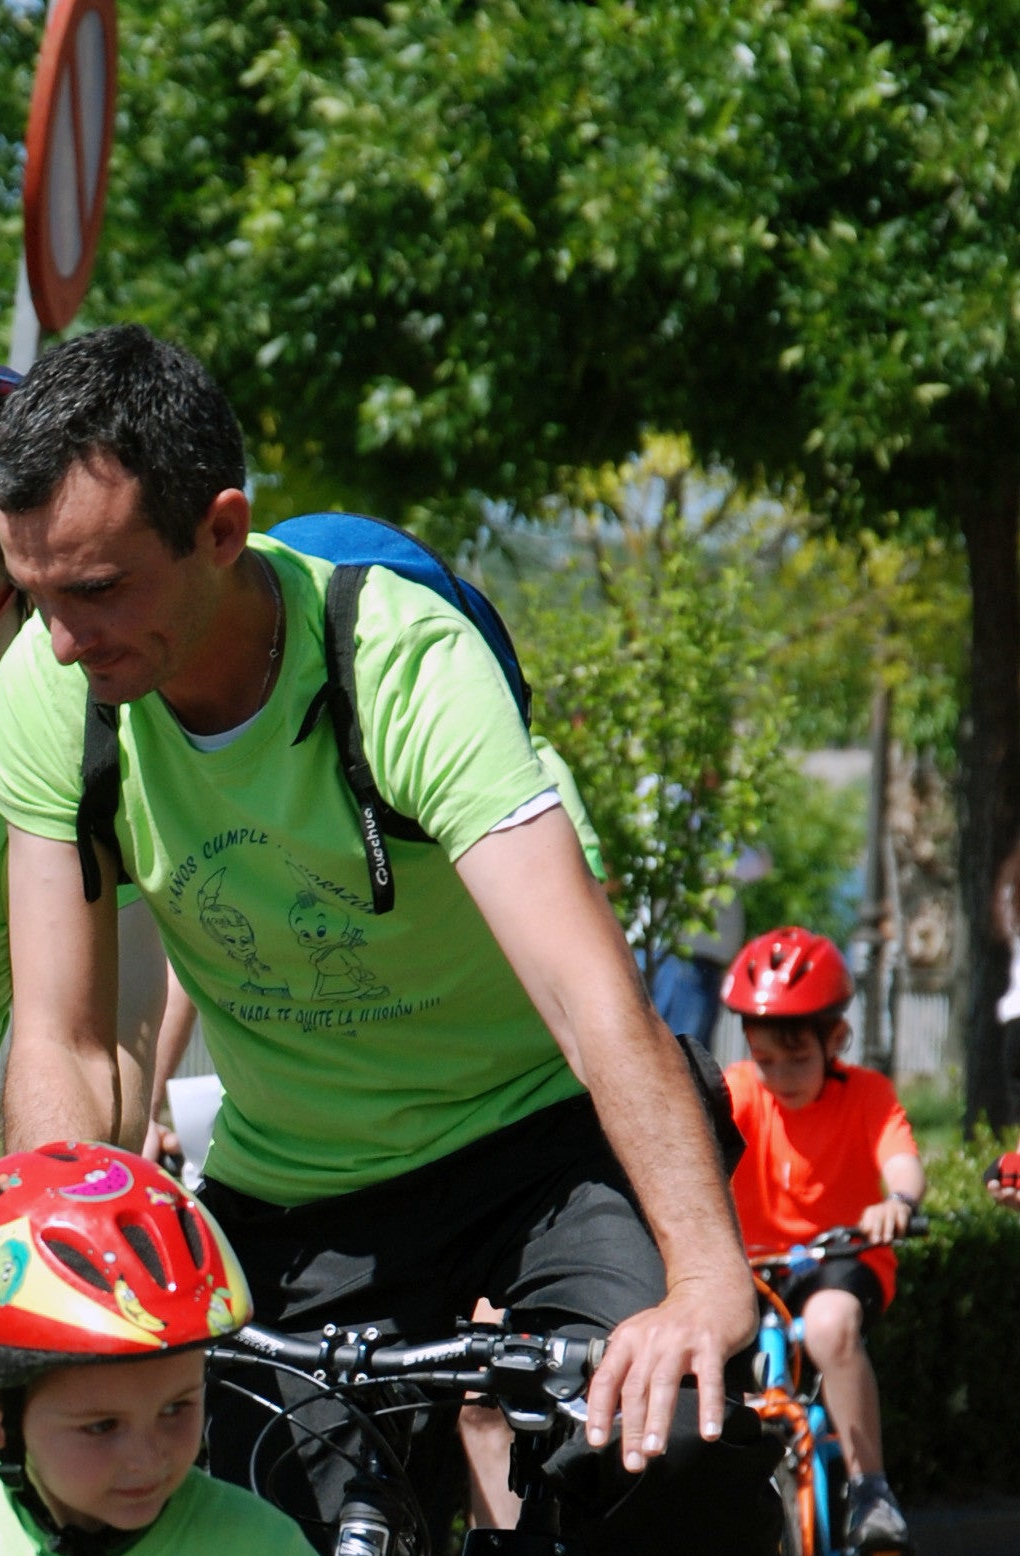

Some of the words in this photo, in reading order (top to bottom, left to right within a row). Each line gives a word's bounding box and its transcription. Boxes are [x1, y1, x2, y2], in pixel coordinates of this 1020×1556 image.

[202, 828, 269, 860] CUMPLE
[364, 807, 388, 886] Quechua
[239, 1004, 271, 1022] NADA
[277, 1008, 292, 1021] TE
[295, 1009, 333, 1028] QUITE
[338, 1009, 353, 1026] LA
